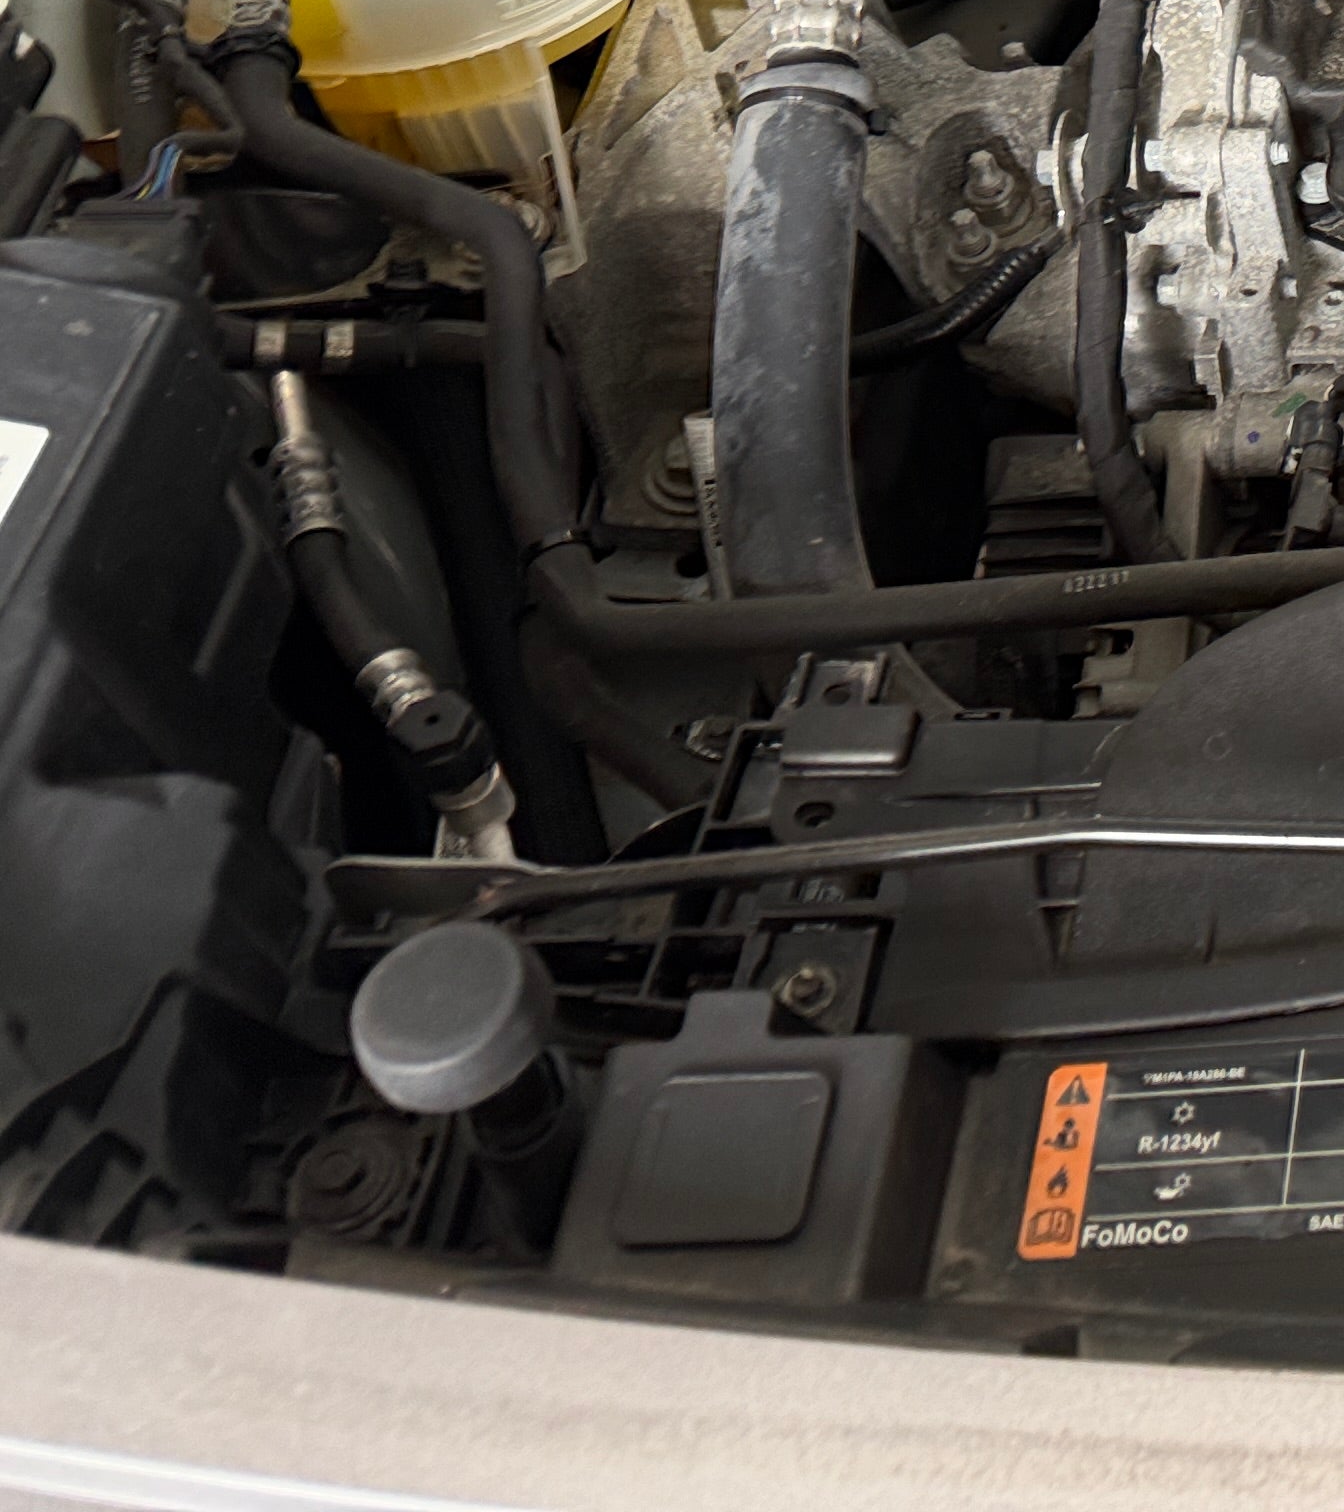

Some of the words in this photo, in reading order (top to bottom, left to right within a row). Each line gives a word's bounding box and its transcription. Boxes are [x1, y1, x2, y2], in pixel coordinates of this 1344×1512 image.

[1137, 1131, 1222, 1154] R-1234yf
[1309, 1213, 1344, 1232] SAE
[1081, 1220, 1189, 1249] FoMoCo
